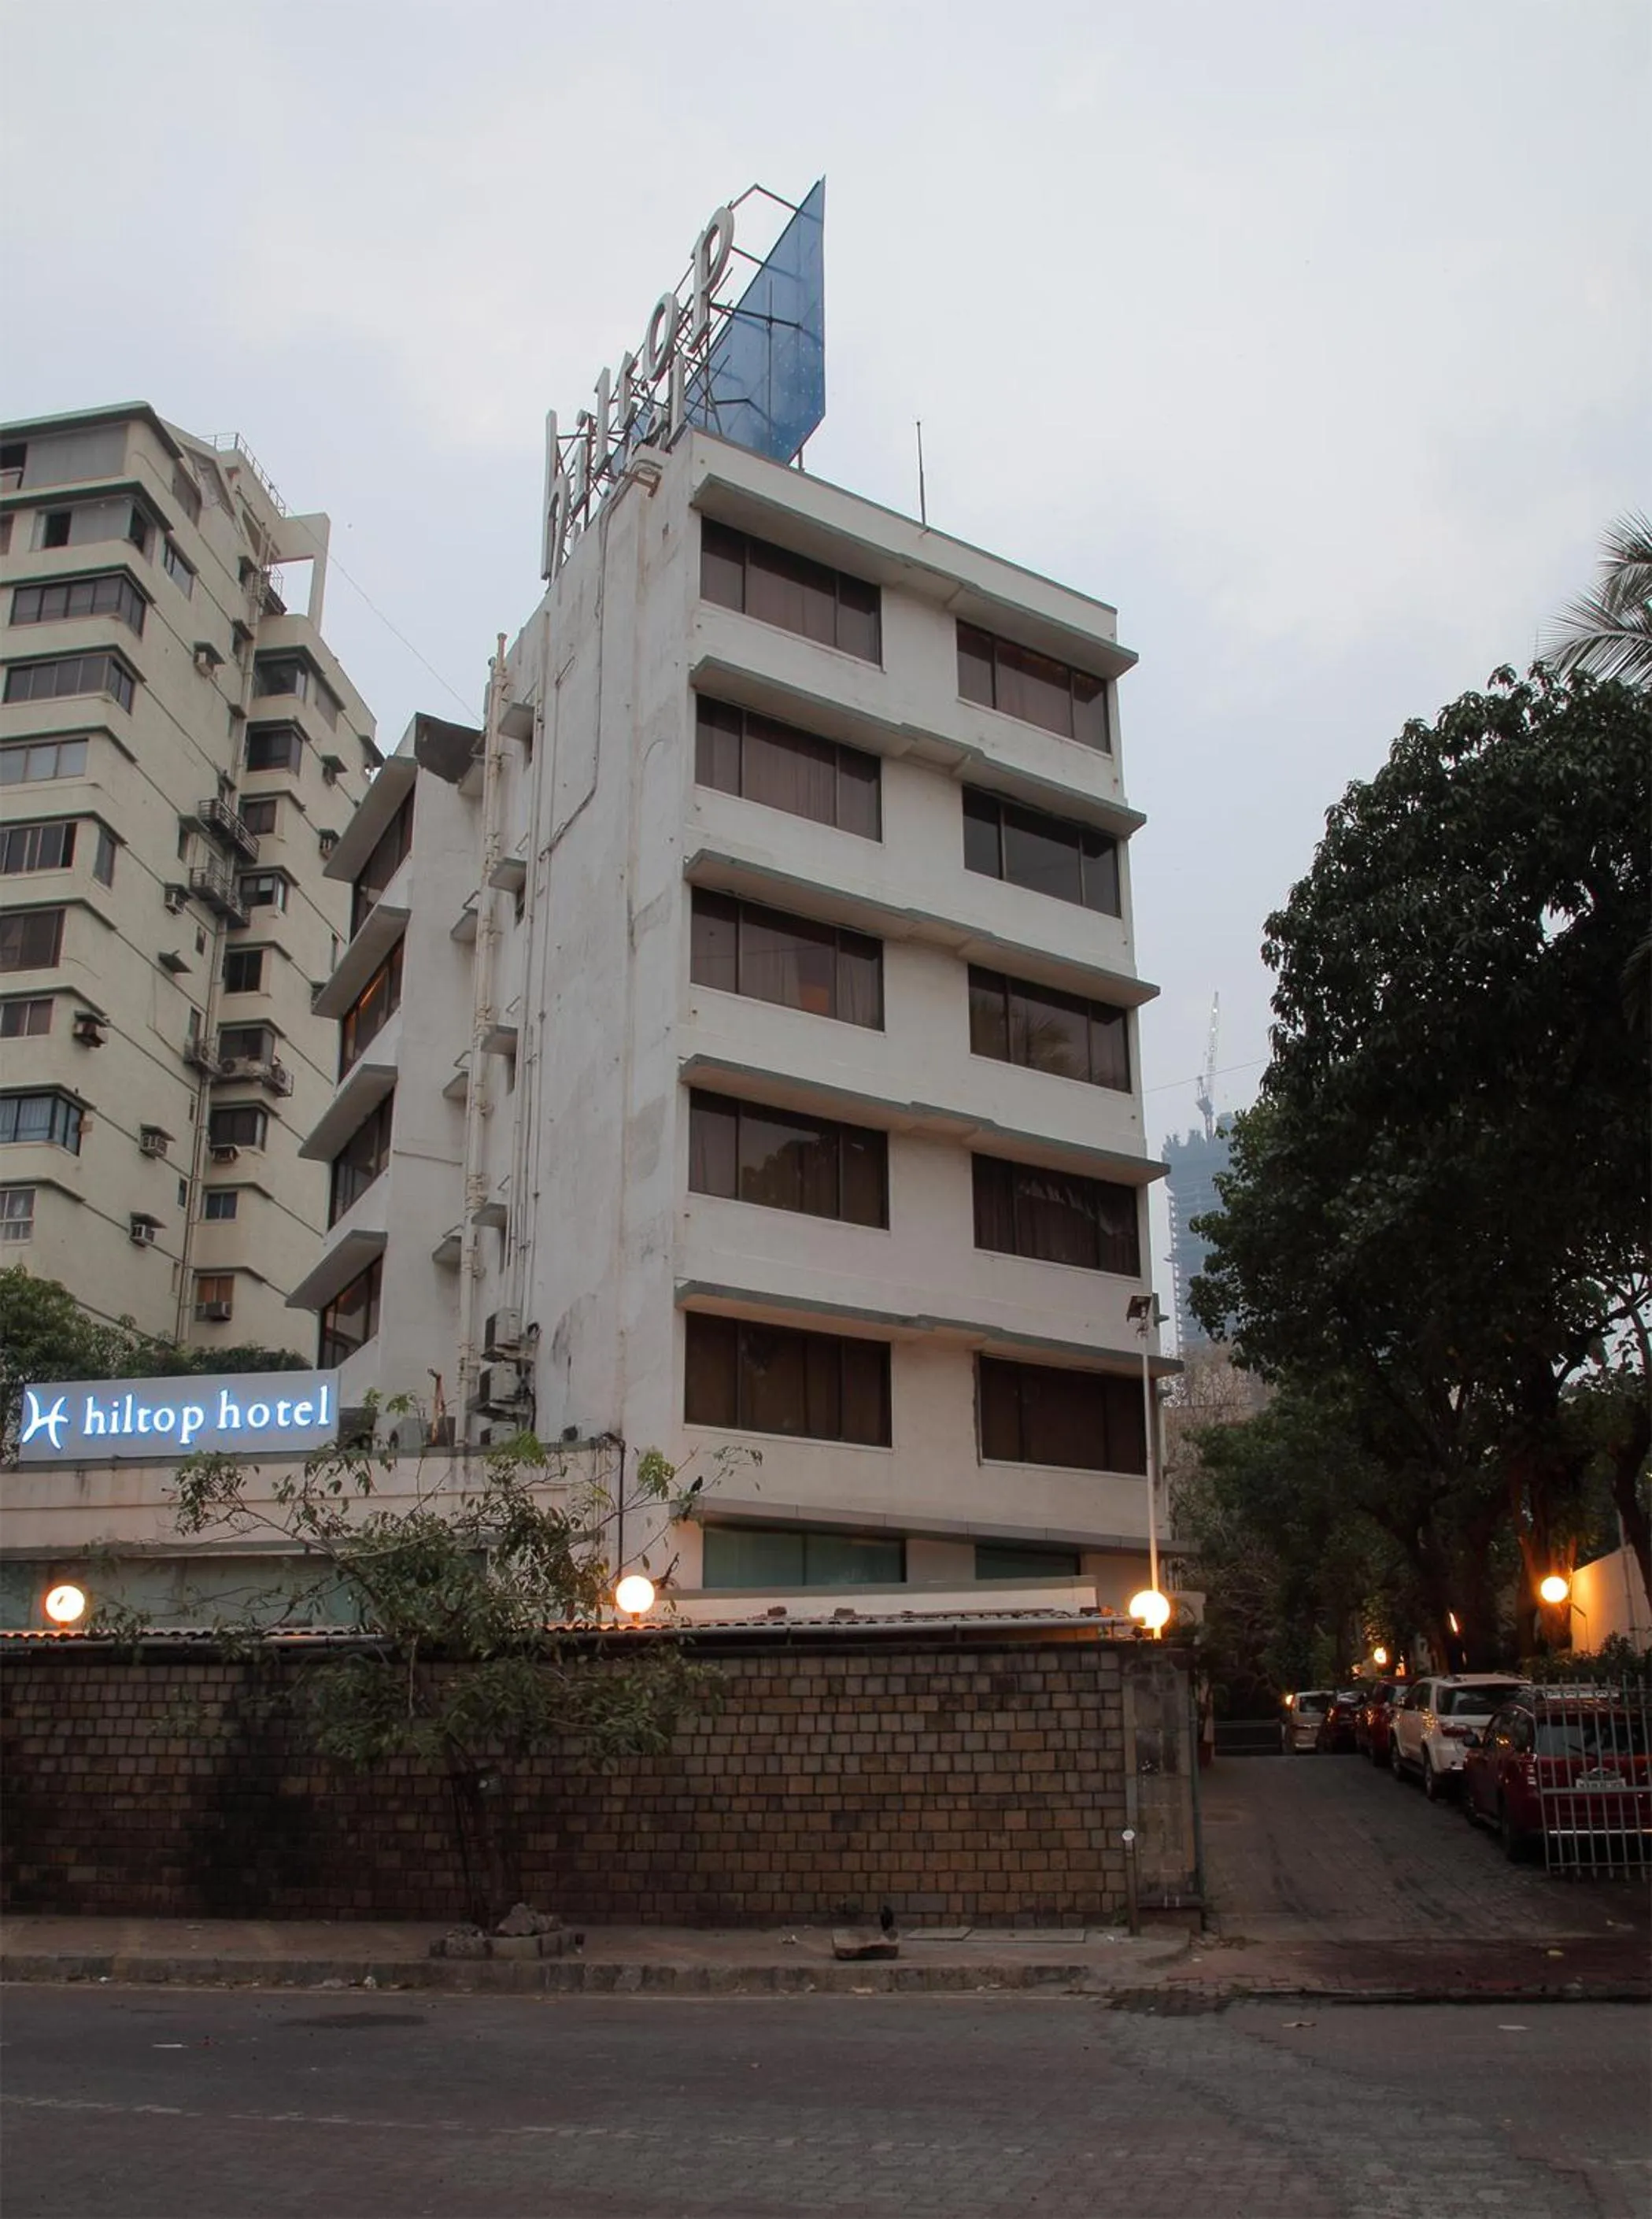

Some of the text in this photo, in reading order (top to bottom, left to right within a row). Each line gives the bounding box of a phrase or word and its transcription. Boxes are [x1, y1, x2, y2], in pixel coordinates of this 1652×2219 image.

[541, 206, 734, 581] hiltop
[83, 1394, 205, 1444] hiltop
[216, 1385, 330, 1429] hotel
